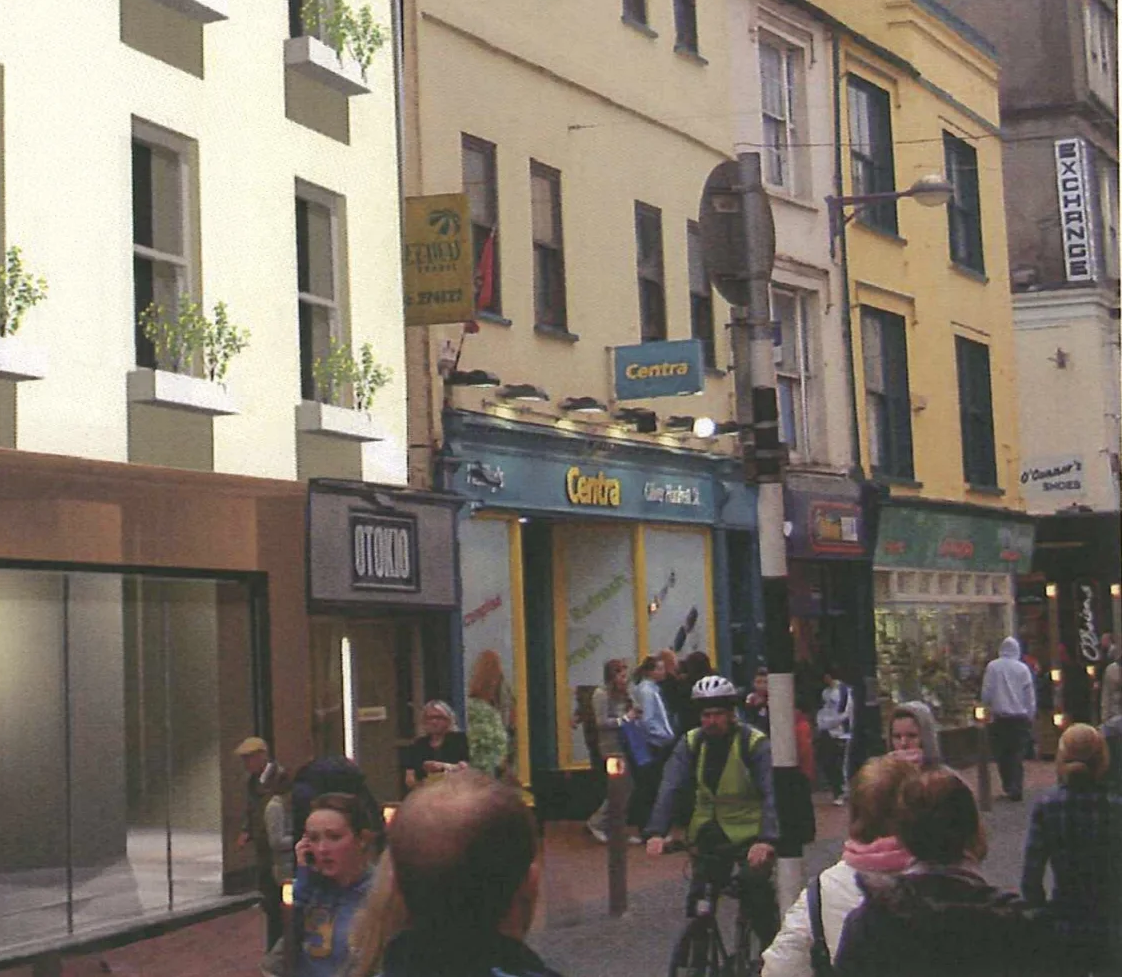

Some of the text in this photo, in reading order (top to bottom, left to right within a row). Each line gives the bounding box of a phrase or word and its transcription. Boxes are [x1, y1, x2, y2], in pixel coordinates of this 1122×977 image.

[1059, 142, 1088, 276] EXCHANGE
[625, 361, 689, 380] Centra
[565, 465, 622, 507] Centra
[1043, 480, 1082, 492] SHOES
